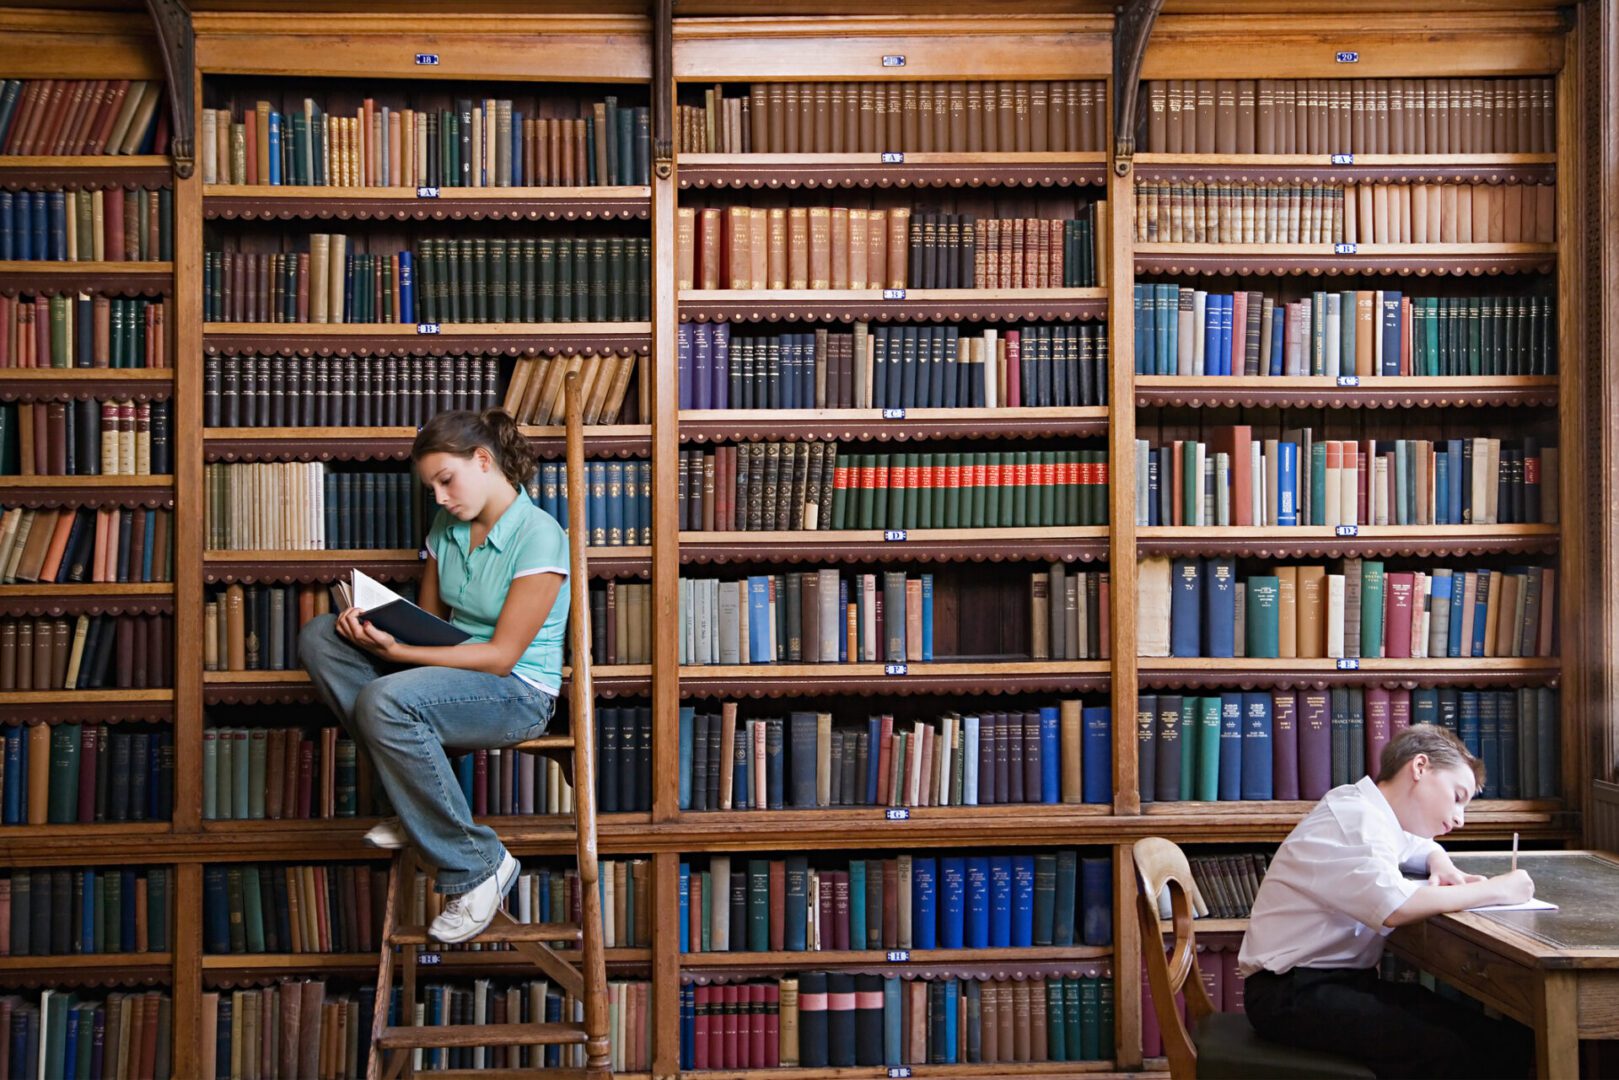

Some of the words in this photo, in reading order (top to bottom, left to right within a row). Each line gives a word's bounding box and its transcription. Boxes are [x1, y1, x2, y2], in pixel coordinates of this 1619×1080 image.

[423, 55, 432, 63] 18
[1341, 53, 1352, 61] 20
[425, 188, 432, 196] A
[894, 952, 901, 960] H
